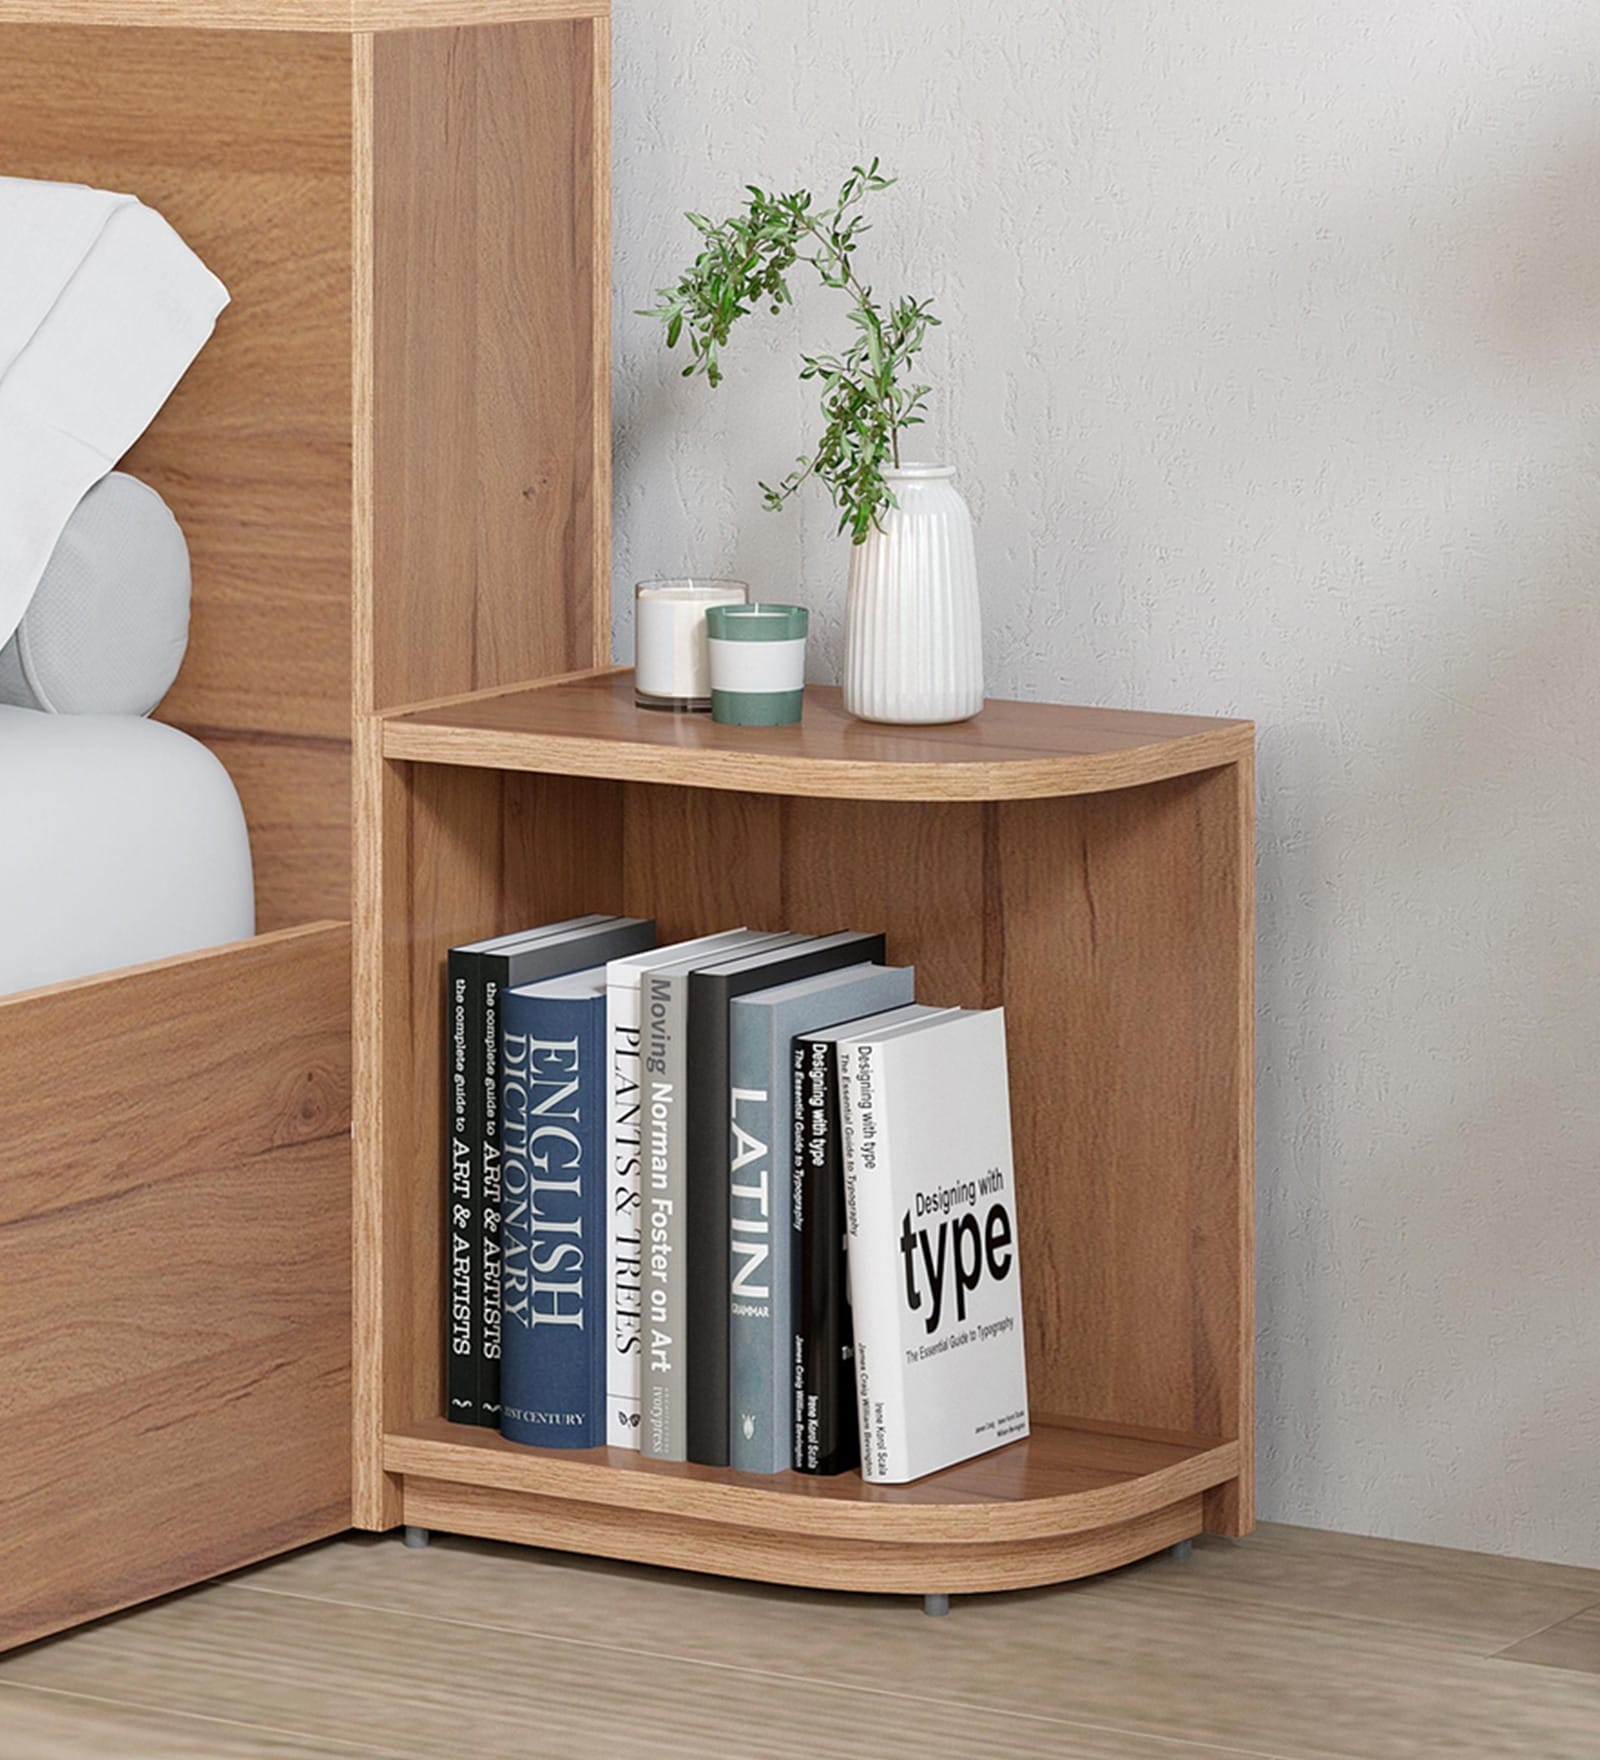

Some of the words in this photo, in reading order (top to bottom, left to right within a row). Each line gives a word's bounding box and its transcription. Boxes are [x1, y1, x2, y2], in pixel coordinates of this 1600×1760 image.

[456, 979, 466, 1003] the
[486, 982, 497, 1007] the
[454, 1006, 467, 1072] complete
[484, 1009, 498, 1075] complete
[646, 978, 671, 1075] Moving
[795, 1049, 804, 1069] The
[809, 1043, 827, 1106] Designing
[841, 1054, 850, 1073] The
[856, 1045, 875, 1108] Designing
[454, 1073, 467, 1115] guide
[484, 1077, 498, 1119] guide
[615, 1024, 641, 1177] PLANTS
[795, 1071, 805, 1120] Essential
[841, 1075, 853, 1125] Essential
[456, 1117, 465, 1132] to
[486, 1121, 496, 1136] to
[651, 1082, 673, 1189] Norman
[795, 1121, 804, 1153] Guide
[812, 1109, 828, 1136] with
[845, 1127, 855, 1158] Guide
[862, 1112, 878, 1139] with
[452, 1137, 471, 1199] ART
[483, 1140, 500, 1202] ART
[795, 1155, 803, 1167] to
[809, 1138, 826, 1167] type
[847, 1161, 854, 1172] to
[860, 1142, 876, 1169] type
[503, 1031, 529, 1329] DICTIONARY
[529, 1033, 584, 1331] ENGLISH
[615, 1186, 641, 1216] &
[731, 1087, 769, 1298] LATIN
[793, 1169, 804, 1232] Typography
[916, 1180, 976, 1217] Designing
[978, 1167, 1004, 1197] with
[453, 1204, 471, 1229] &
[483, 1207, 500, 1232] &
[847, 1175, 859, 1236] Typography
[651, 1198, 673, 1284] Foster
[900, 1203, 1012, 1334] type
[452, 1233, 471, 1356] ARTISTS
[483, 1236, 501, 1360] ARTISTS
[615, 1228, 641, 1355] TREES
[651, 1290, 668, 1324] on
[651, 1329, 672, 1373] Art
[523, 1410, 585, 1425] CENTURY
[650, 1386, 664, 1453] ivorypress
[808, 1419, 819, 1443] Korol
[876, 1426, 887, 1450] Korol
[808, 1444, 819, 1469] Scala
[878, 1452, 889, 1476] Scala
